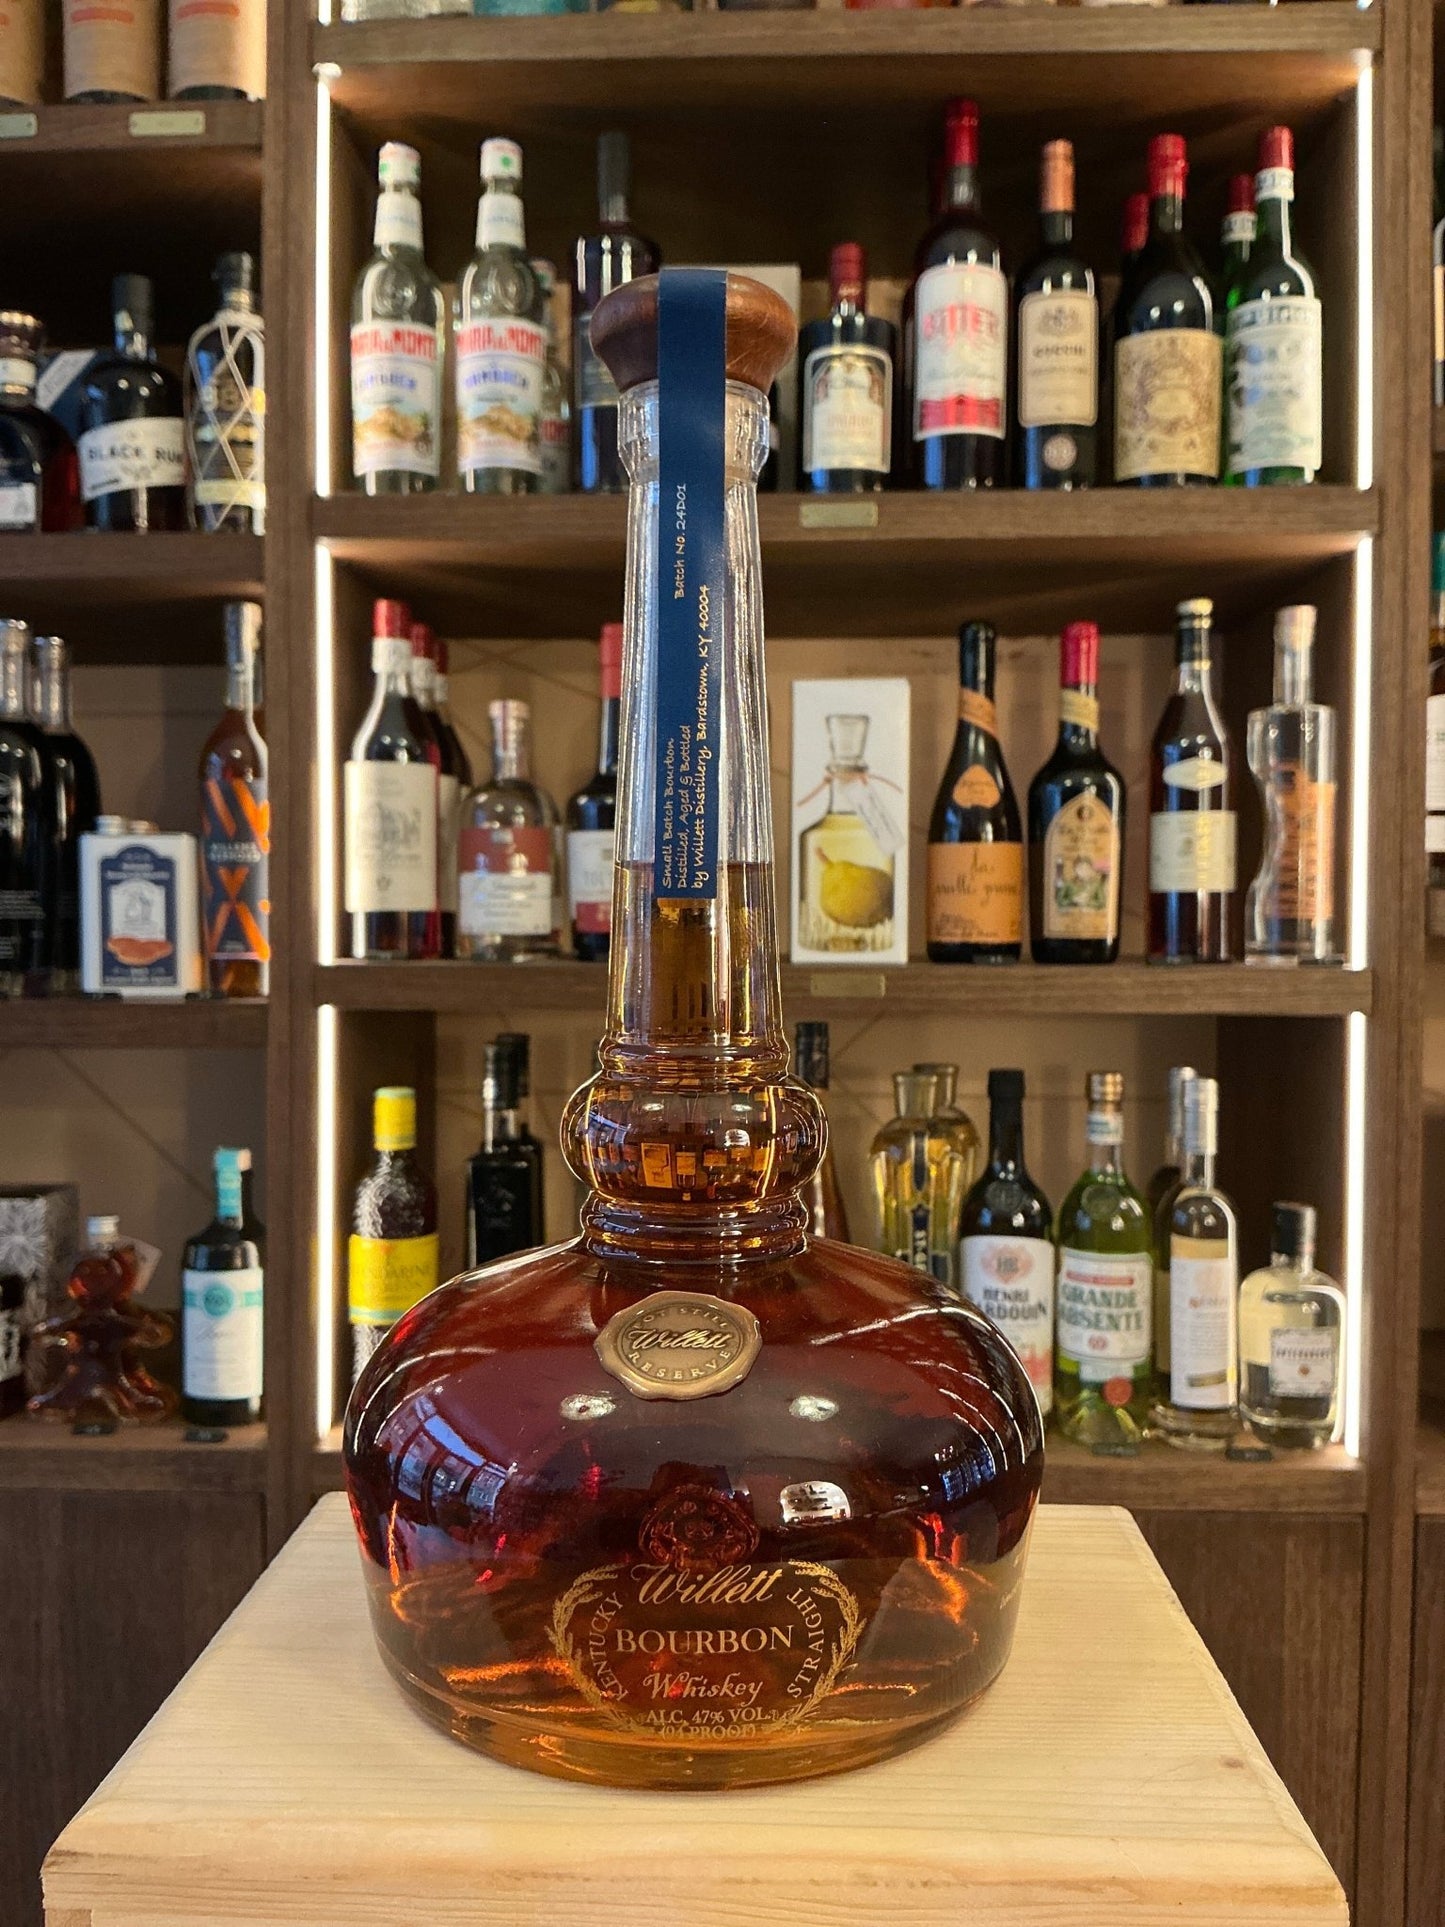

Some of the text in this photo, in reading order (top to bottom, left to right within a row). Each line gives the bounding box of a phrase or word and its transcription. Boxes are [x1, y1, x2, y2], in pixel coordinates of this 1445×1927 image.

[675, 483, 687, 599] Batch No. 24D01
[691, 584, 713, 889] by Willett Distillery, Bardstown, KY 40004
[662, 737, 675, 889] Small Batch Bourbon
[676, 724, 693, 889] Distilled, Aged & Bottled
[983, 1287, 1030, 1302] HENRI
[1061, 1284, 1138, 1309] GRANDE
[628, 1328, 733, 1351] Willett
[628, 1351, 731, 1379] RESERVE
[630, 1563, 783, 1605] Willett
[589, 1592, 629, 1701] KENTUCKY
[615, 1624, 795, 1655] BOURBON
[786, 1587, 824, 1698] STRAIGHT
[642, 1671, 764, 1707] Whiskey
[692, 1710, 725, 1724] 47%
